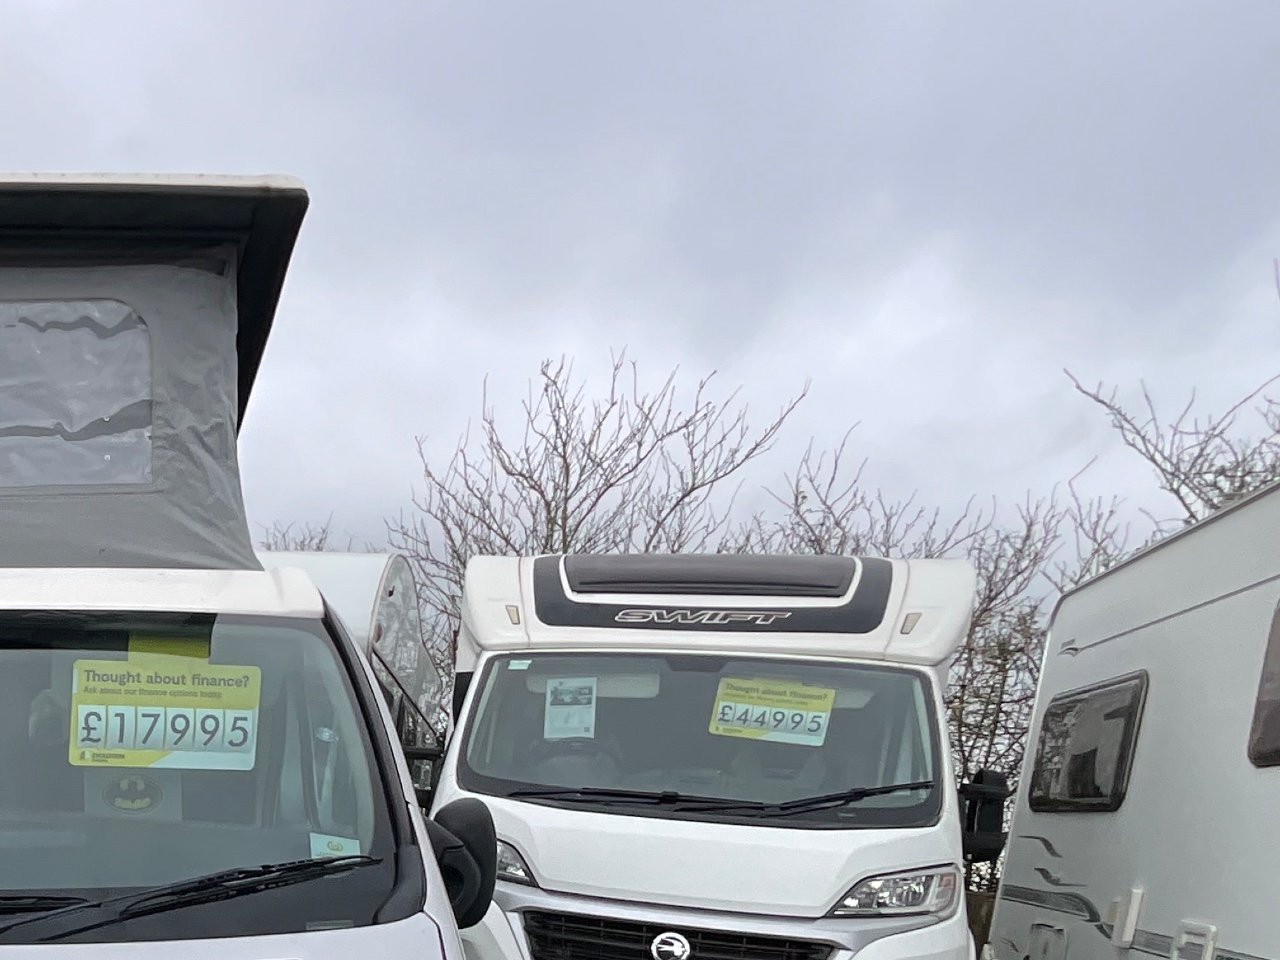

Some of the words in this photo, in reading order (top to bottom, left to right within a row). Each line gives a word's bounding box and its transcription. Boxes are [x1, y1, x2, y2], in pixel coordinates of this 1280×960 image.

[615, 609, 792, 625] SWIFT
[84, 669, 142, 686] Thought
[146, 672, 186, 686] about
[191, 673, 250, 688] finance?
[81, 711, 249, 747] £17995
[718, 705, 823, 733] £44995
